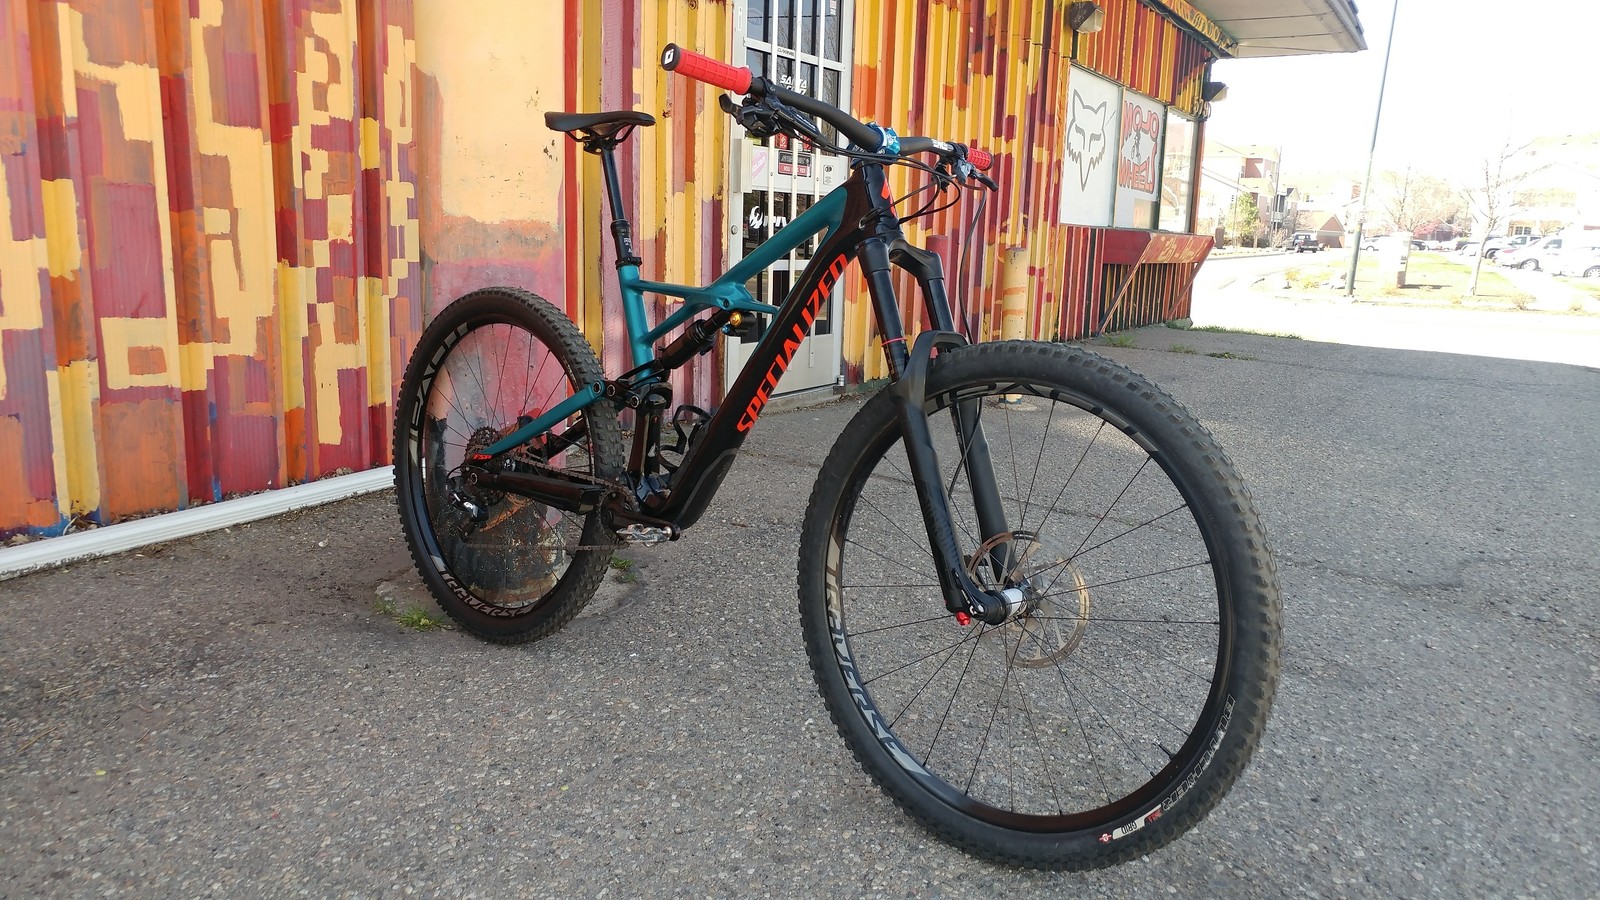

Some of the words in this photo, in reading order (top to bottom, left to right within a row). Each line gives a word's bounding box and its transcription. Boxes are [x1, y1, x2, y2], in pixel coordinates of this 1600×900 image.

[780, 75, 807, 88] SATA
[1123, 100, 1160, 143] MOJO
[1118, 142, 1158, 194] WHEELS
[736, 253, 849, 433] SPECIALIZED
[1121, 821, 1138, 835] GRID
